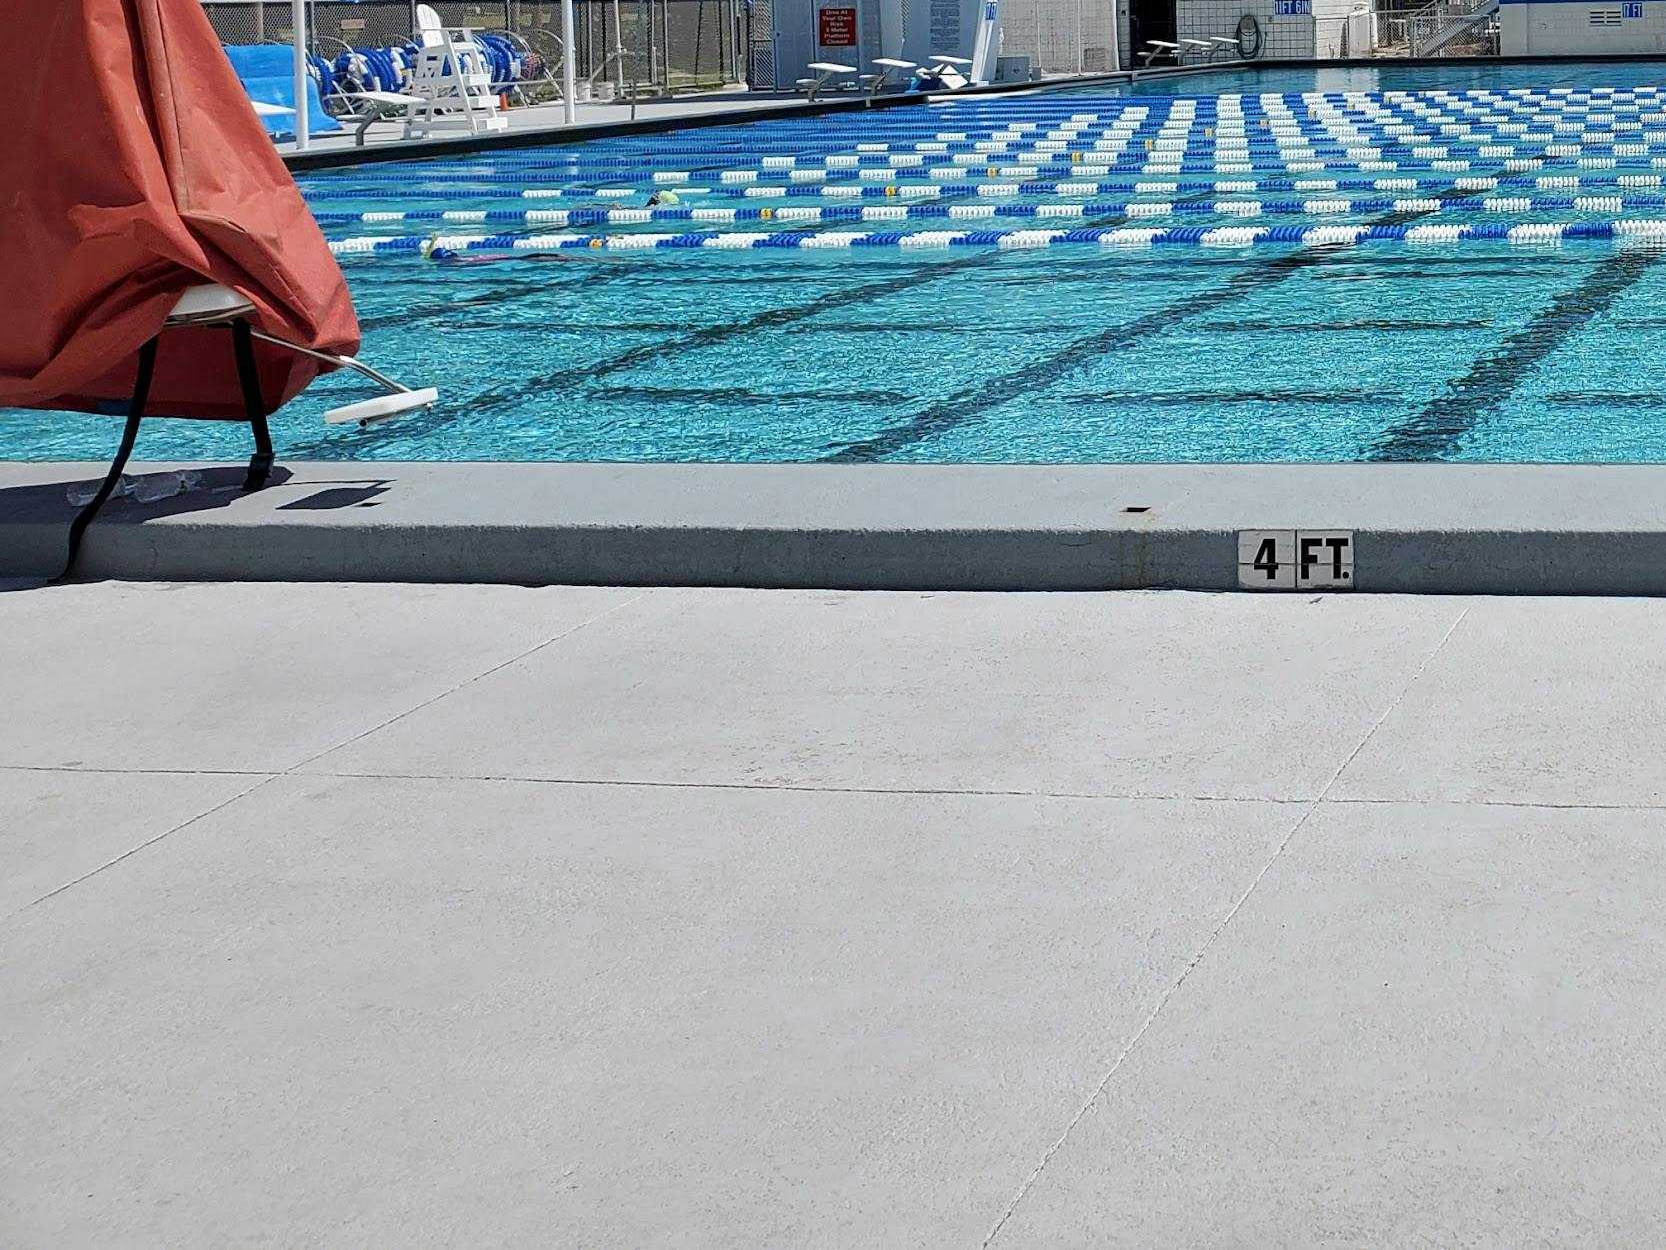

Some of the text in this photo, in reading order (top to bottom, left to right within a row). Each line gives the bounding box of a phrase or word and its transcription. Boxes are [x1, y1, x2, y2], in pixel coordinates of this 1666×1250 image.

[1295, 0, 1310, 14] 6IN
[1632, 3, 1641, 17] FT
[1253, 538, 1279, 580] 4
